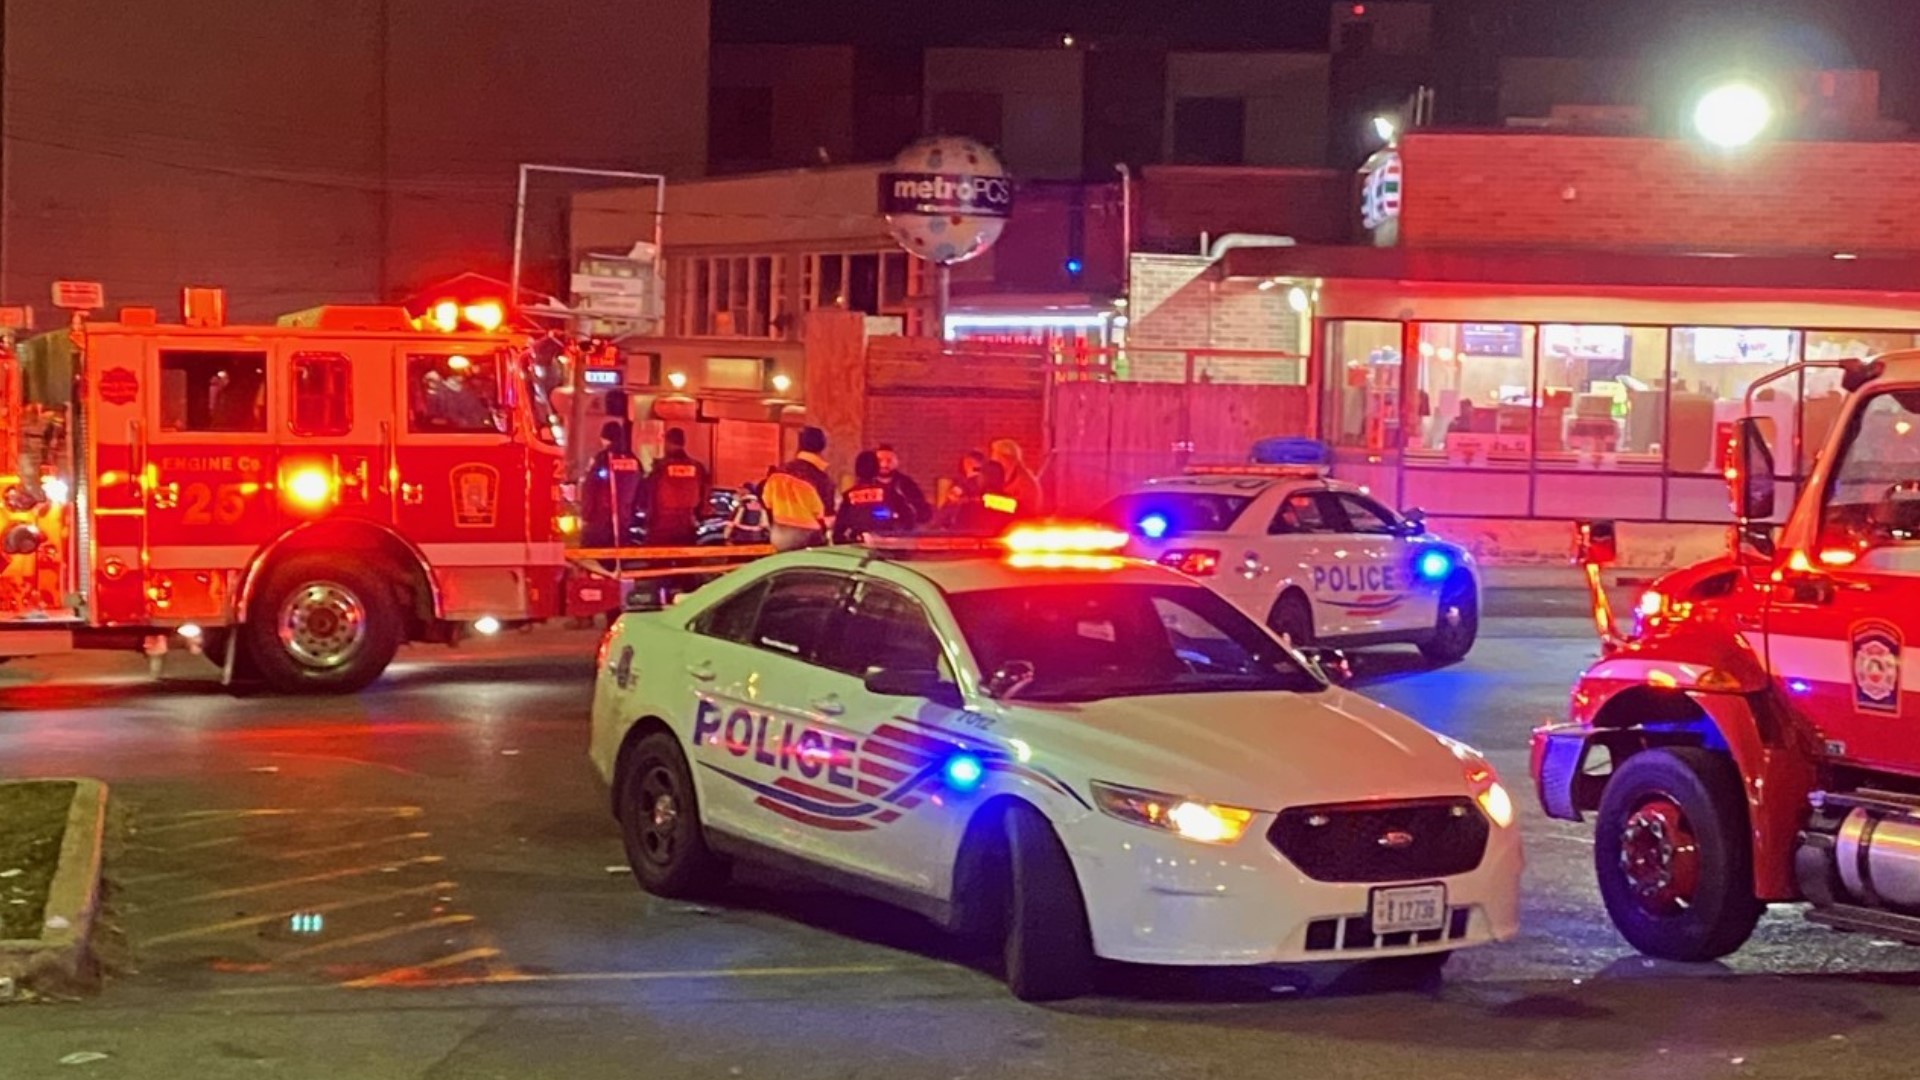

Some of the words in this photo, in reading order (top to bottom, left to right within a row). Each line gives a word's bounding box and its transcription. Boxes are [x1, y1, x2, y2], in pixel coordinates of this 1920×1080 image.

[893, 176, 1010, 204] metroPCS
[162, 456, 233, 472] ENGINE
[181, 481, 246, 526] 25
[1313, 565, 1395, 592] POLICE
[693, 699, 857, 790] POLICE
